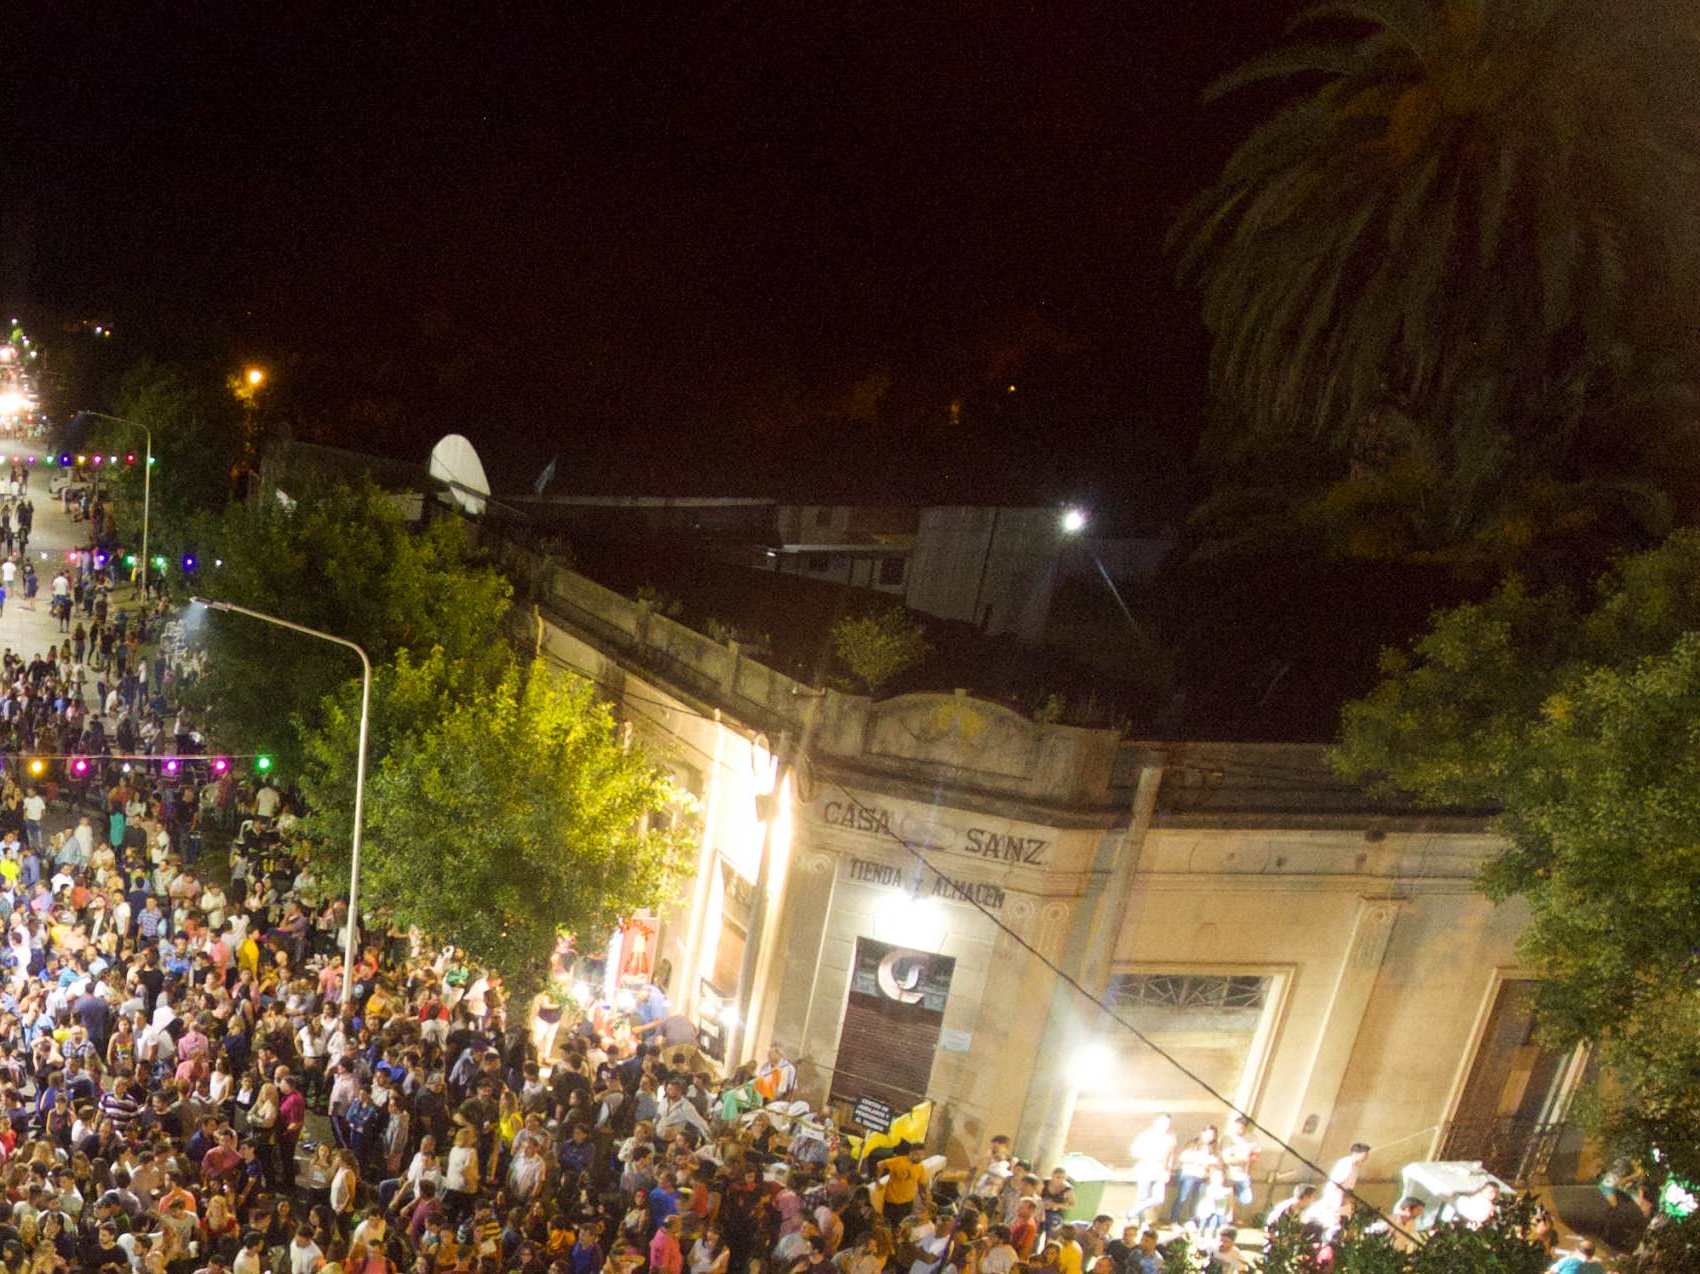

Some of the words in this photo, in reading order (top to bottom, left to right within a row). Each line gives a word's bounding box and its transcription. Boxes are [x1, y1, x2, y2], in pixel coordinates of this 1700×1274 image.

[823, 801, 892, 835] CASA
[964, 827, 1048, 866] SANZ
[849, 858, 903, 887] TIENDA
[932, 876, 1006, 909] ALMACEN
